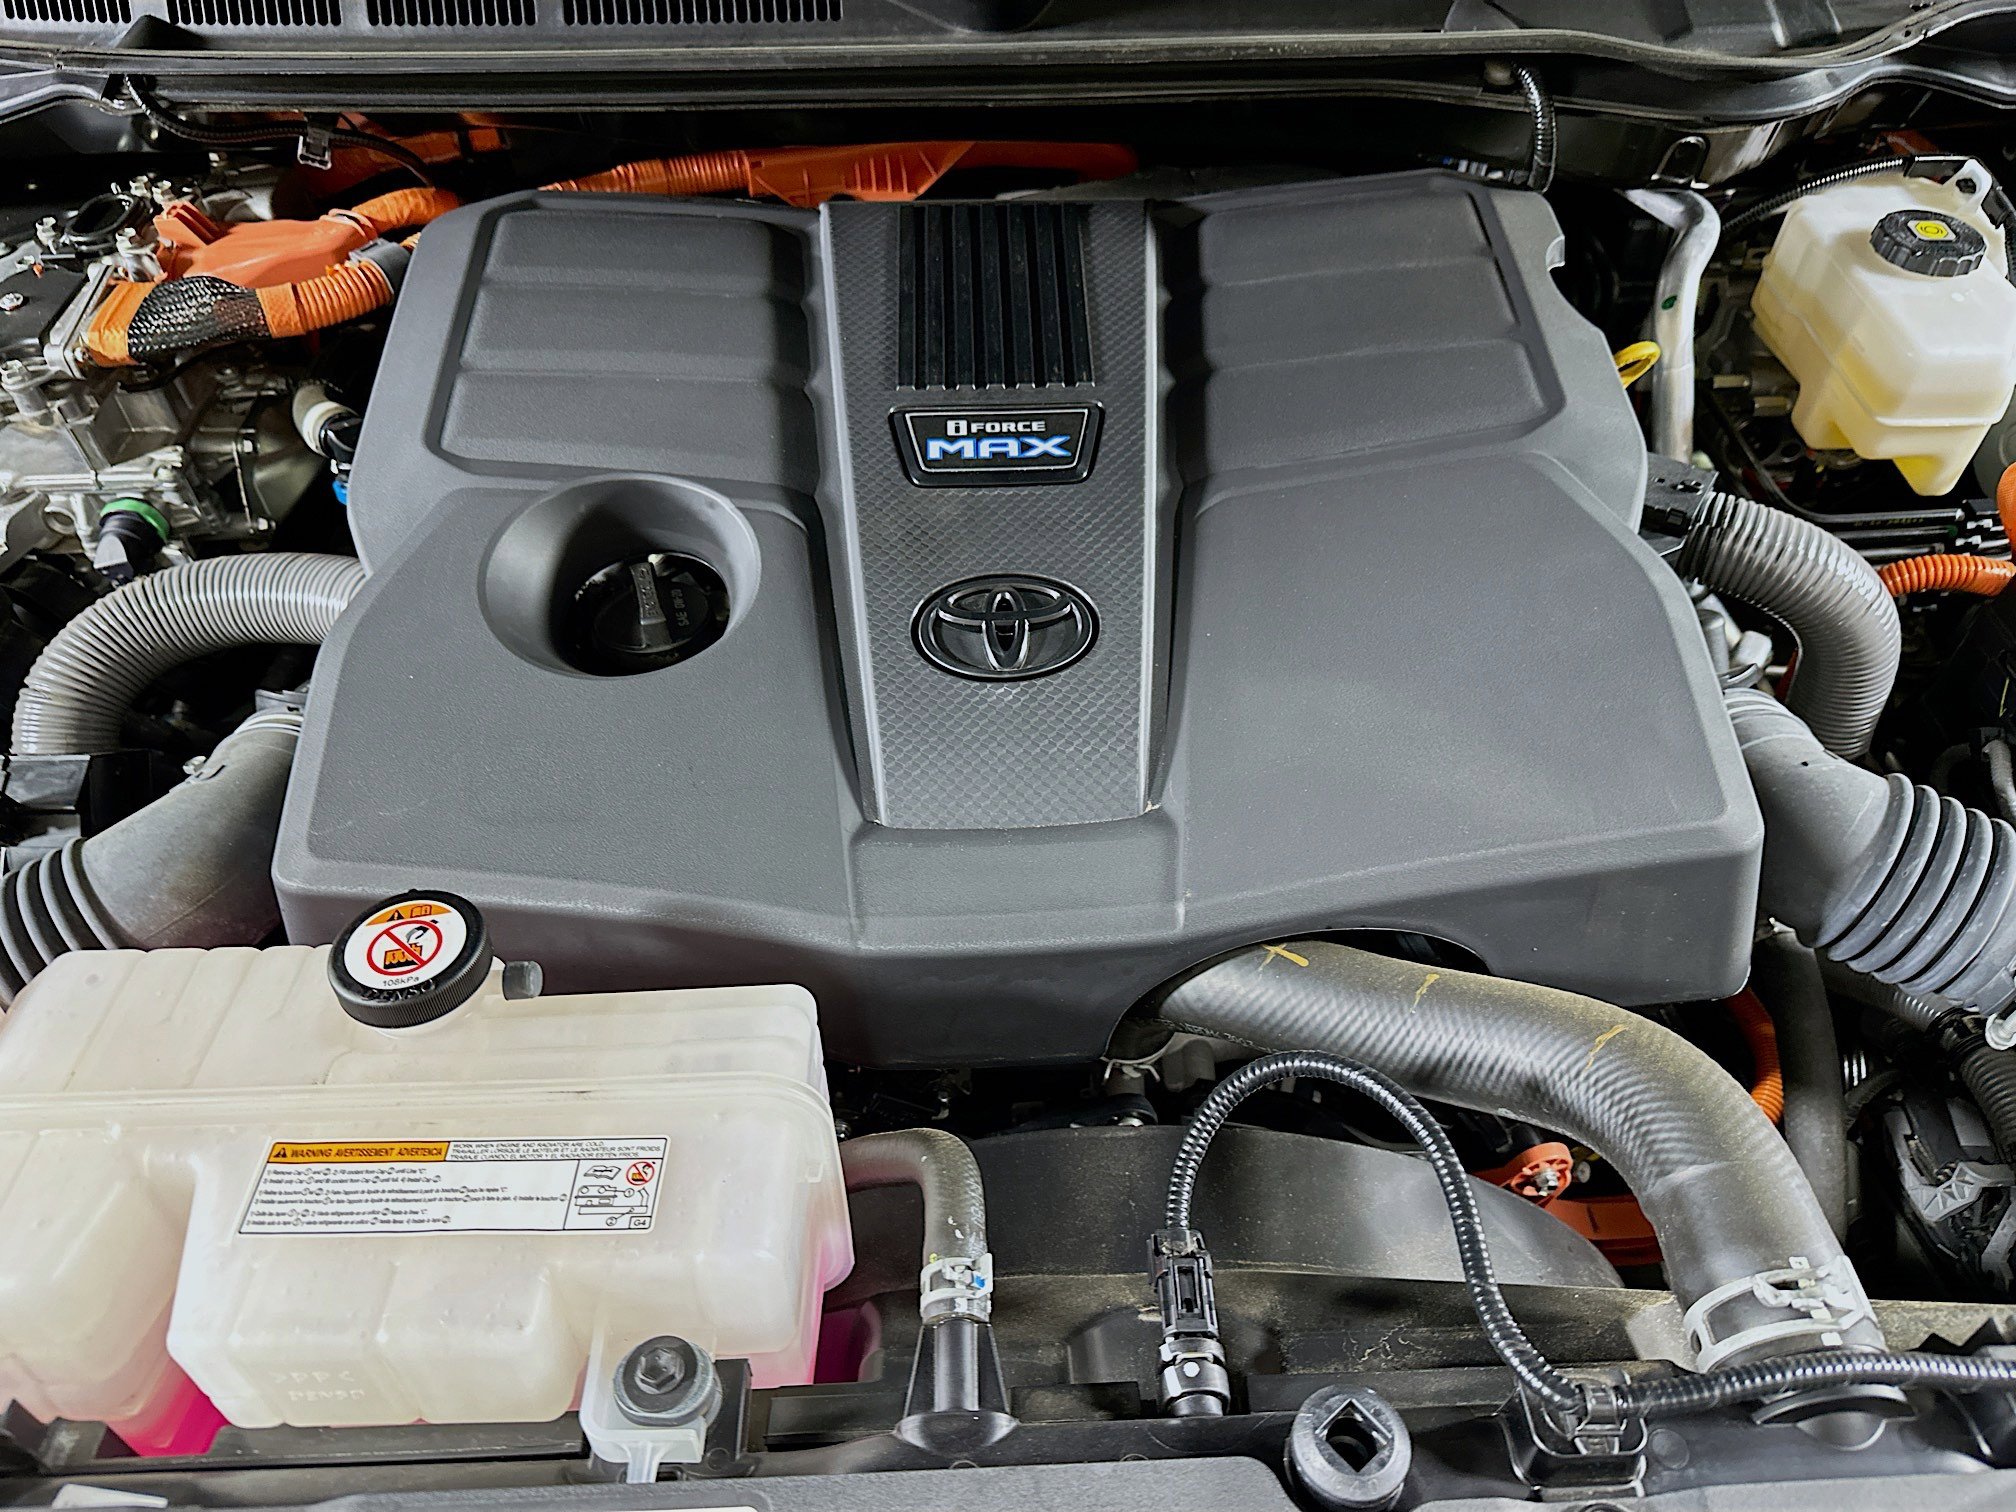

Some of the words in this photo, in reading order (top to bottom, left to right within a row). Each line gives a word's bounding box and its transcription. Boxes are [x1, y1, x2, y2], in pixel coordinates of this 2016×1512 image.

[971, 421, 1046, 433] FORCE
[926, 436, 1072, 461] MAX
[382, 976, 420, 987] 108kPa
[291, 1149, 332, 1158] WARNING
[634, 1219, 646, 1227] G4
